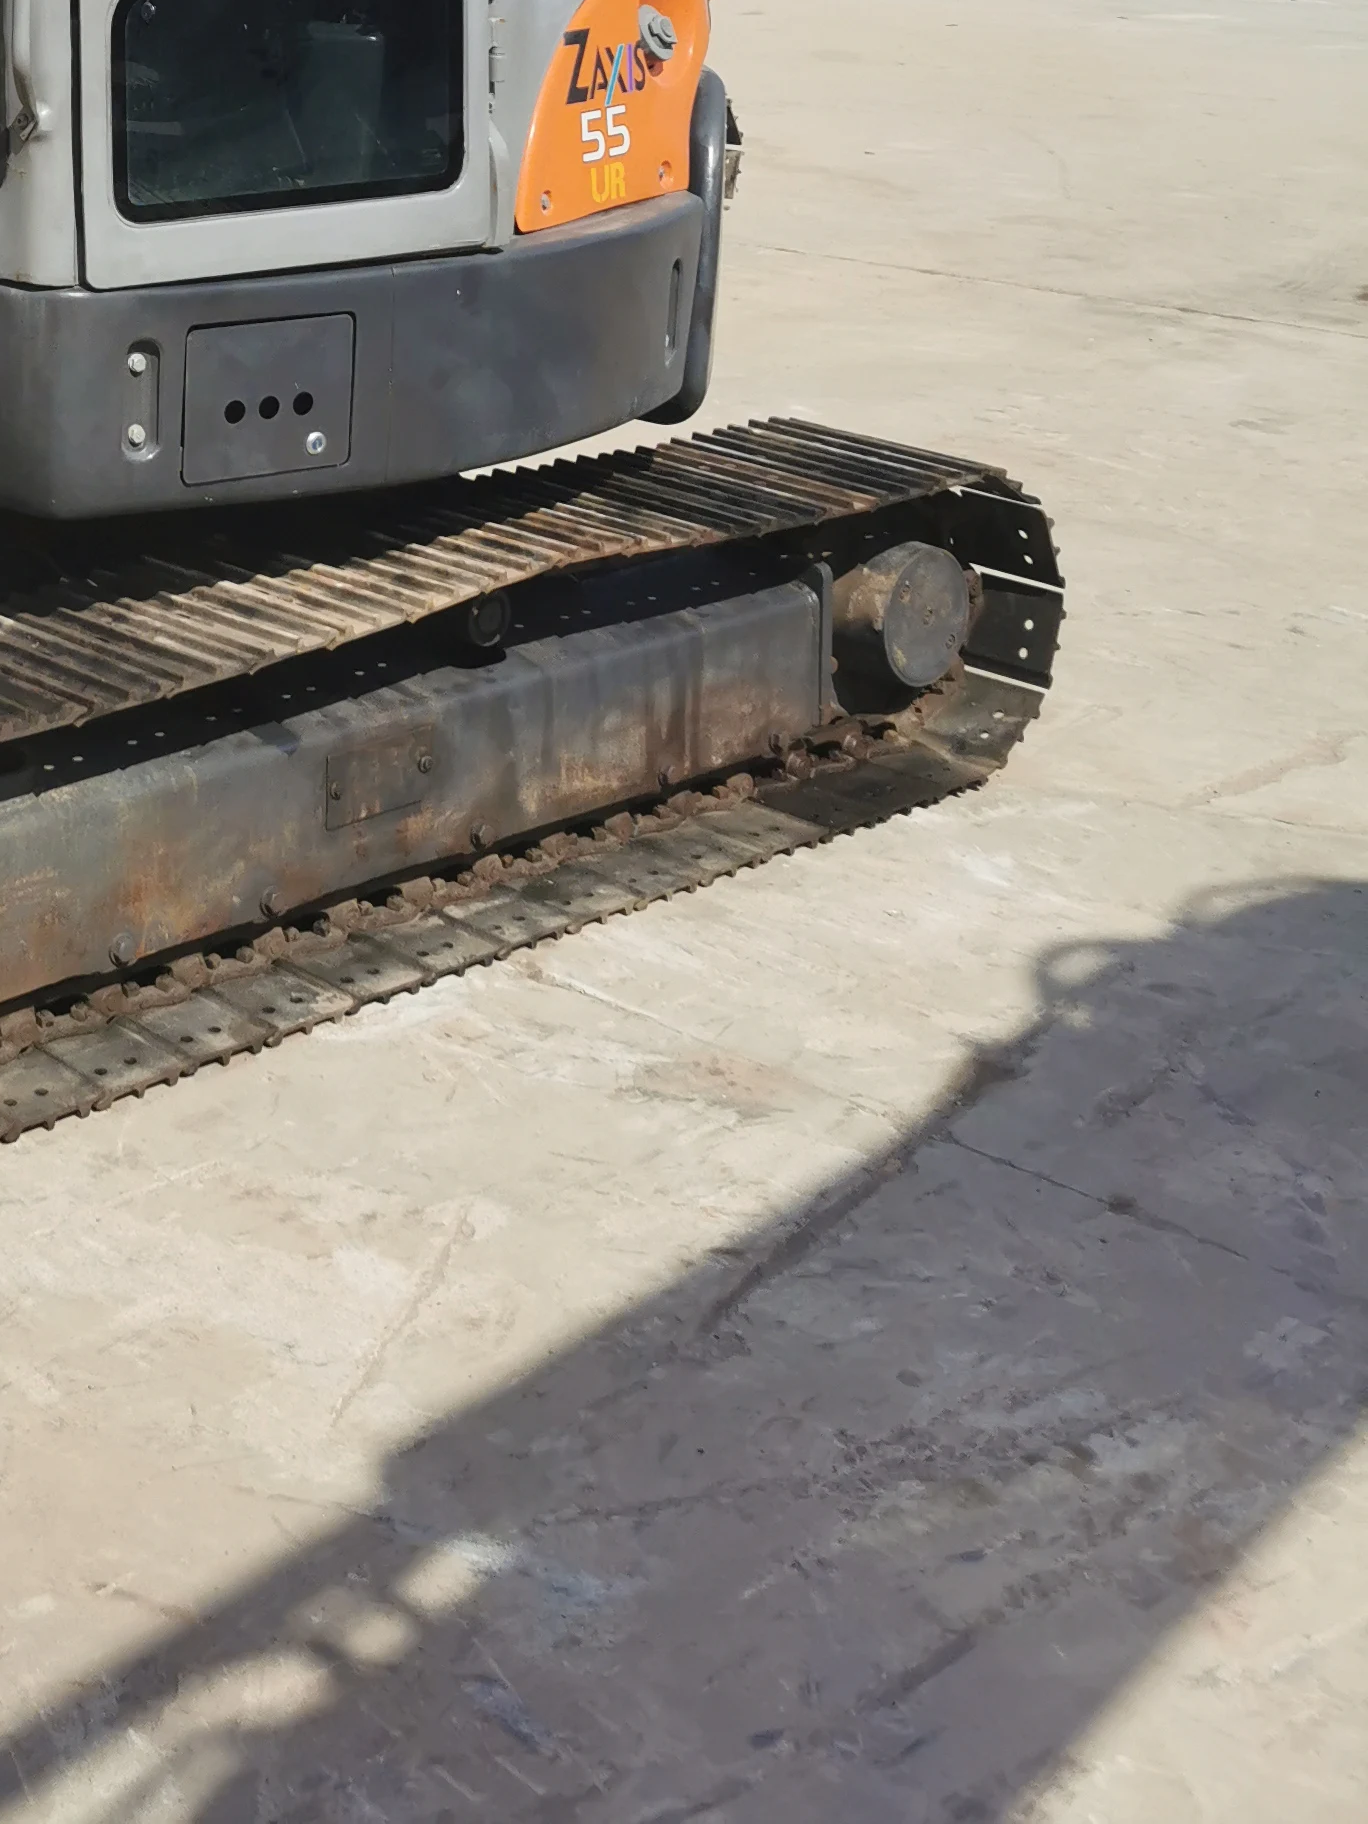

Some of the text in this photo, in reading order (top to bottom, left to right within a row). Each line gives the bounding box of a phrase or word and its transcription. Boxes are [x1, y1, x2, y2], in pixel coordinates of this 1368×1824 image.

[563, 28, 646, 106] ZAXIS
[581, 105, 631, 163] 55
[590, 161, 626, 203] UR
